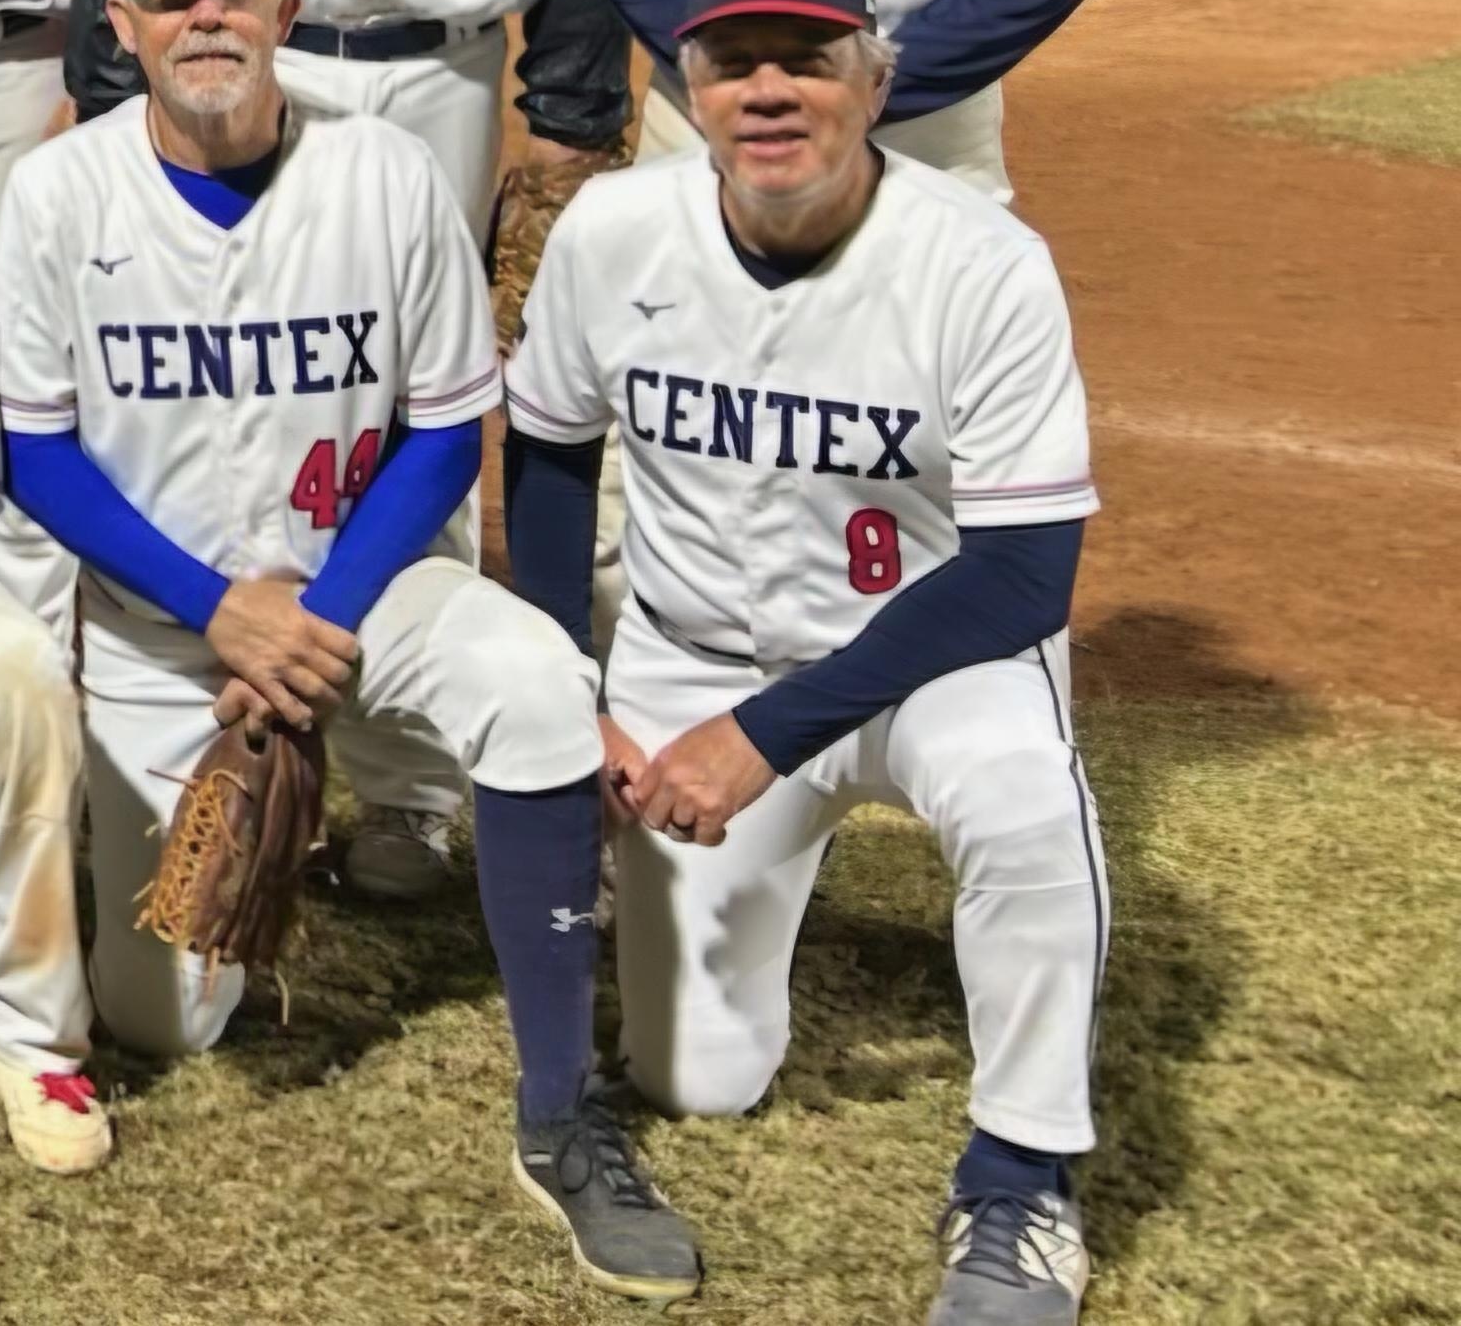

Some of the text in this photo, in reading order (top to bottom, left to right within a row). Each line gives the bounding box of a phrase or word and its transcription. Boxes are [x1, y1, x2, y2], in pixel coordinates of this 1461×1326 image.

[97, 310, 379, 399] CENTEX
[625, 367, 922, 481] CENTEX
[845, 506, 903, 596] 8
